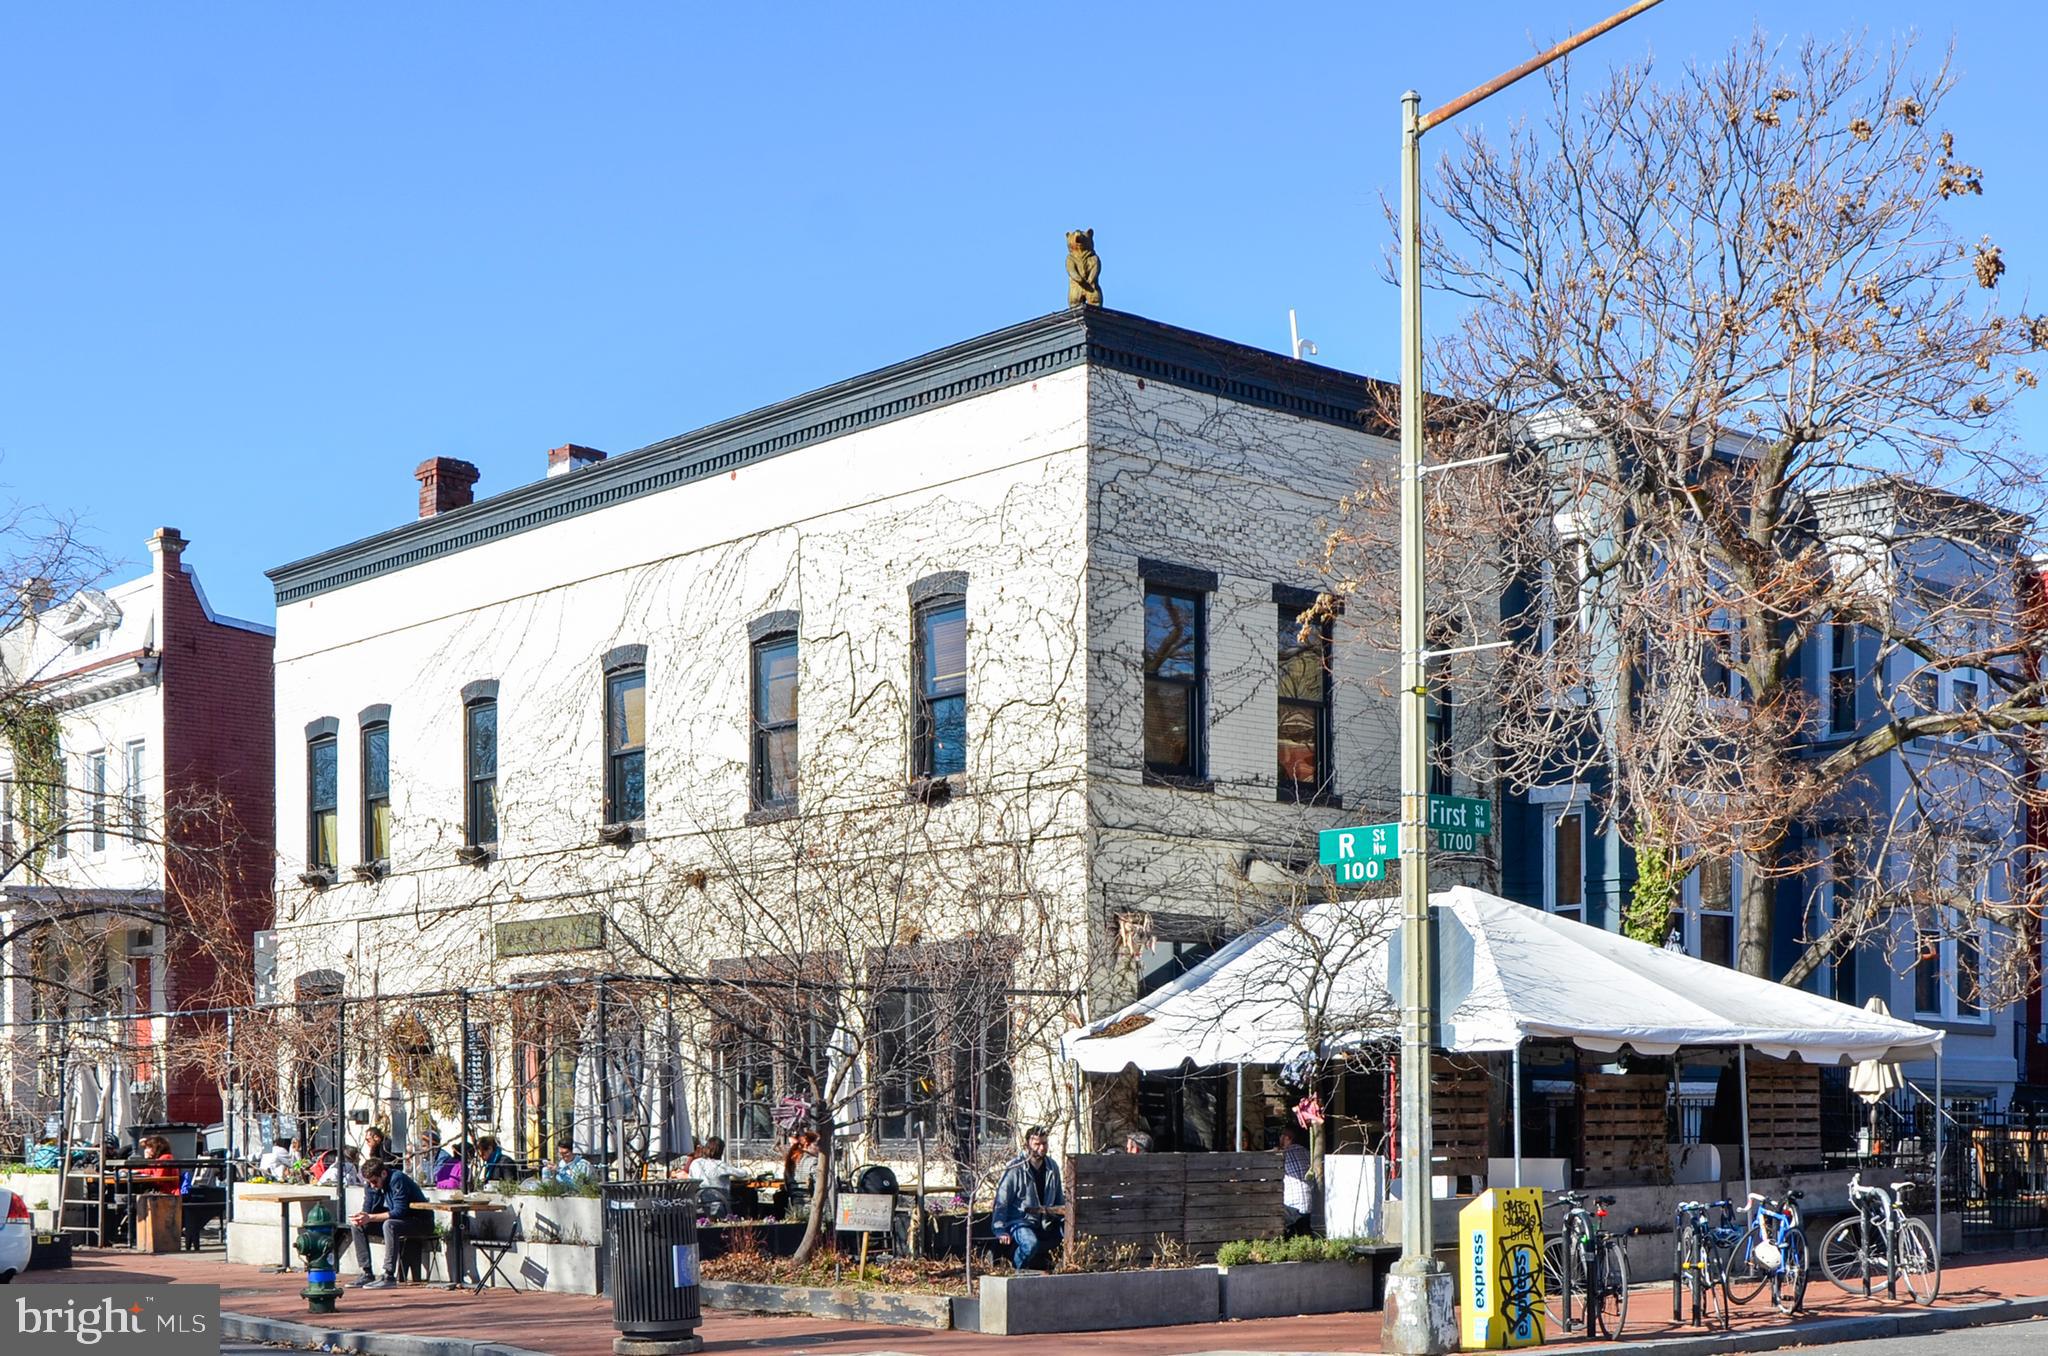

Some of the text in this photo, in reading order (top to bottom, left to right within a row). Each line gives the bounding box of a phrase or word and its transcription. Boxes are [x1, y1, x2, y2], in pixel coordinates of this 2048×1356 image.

[1430, 799, 1484, 828] First St
[1338, 828, 1386, 859] R St
[1442, 833, 1473, 851] 1700
[1343, 860, 1379, 881] 100
[1473, 1234, 1485, 1309] express
